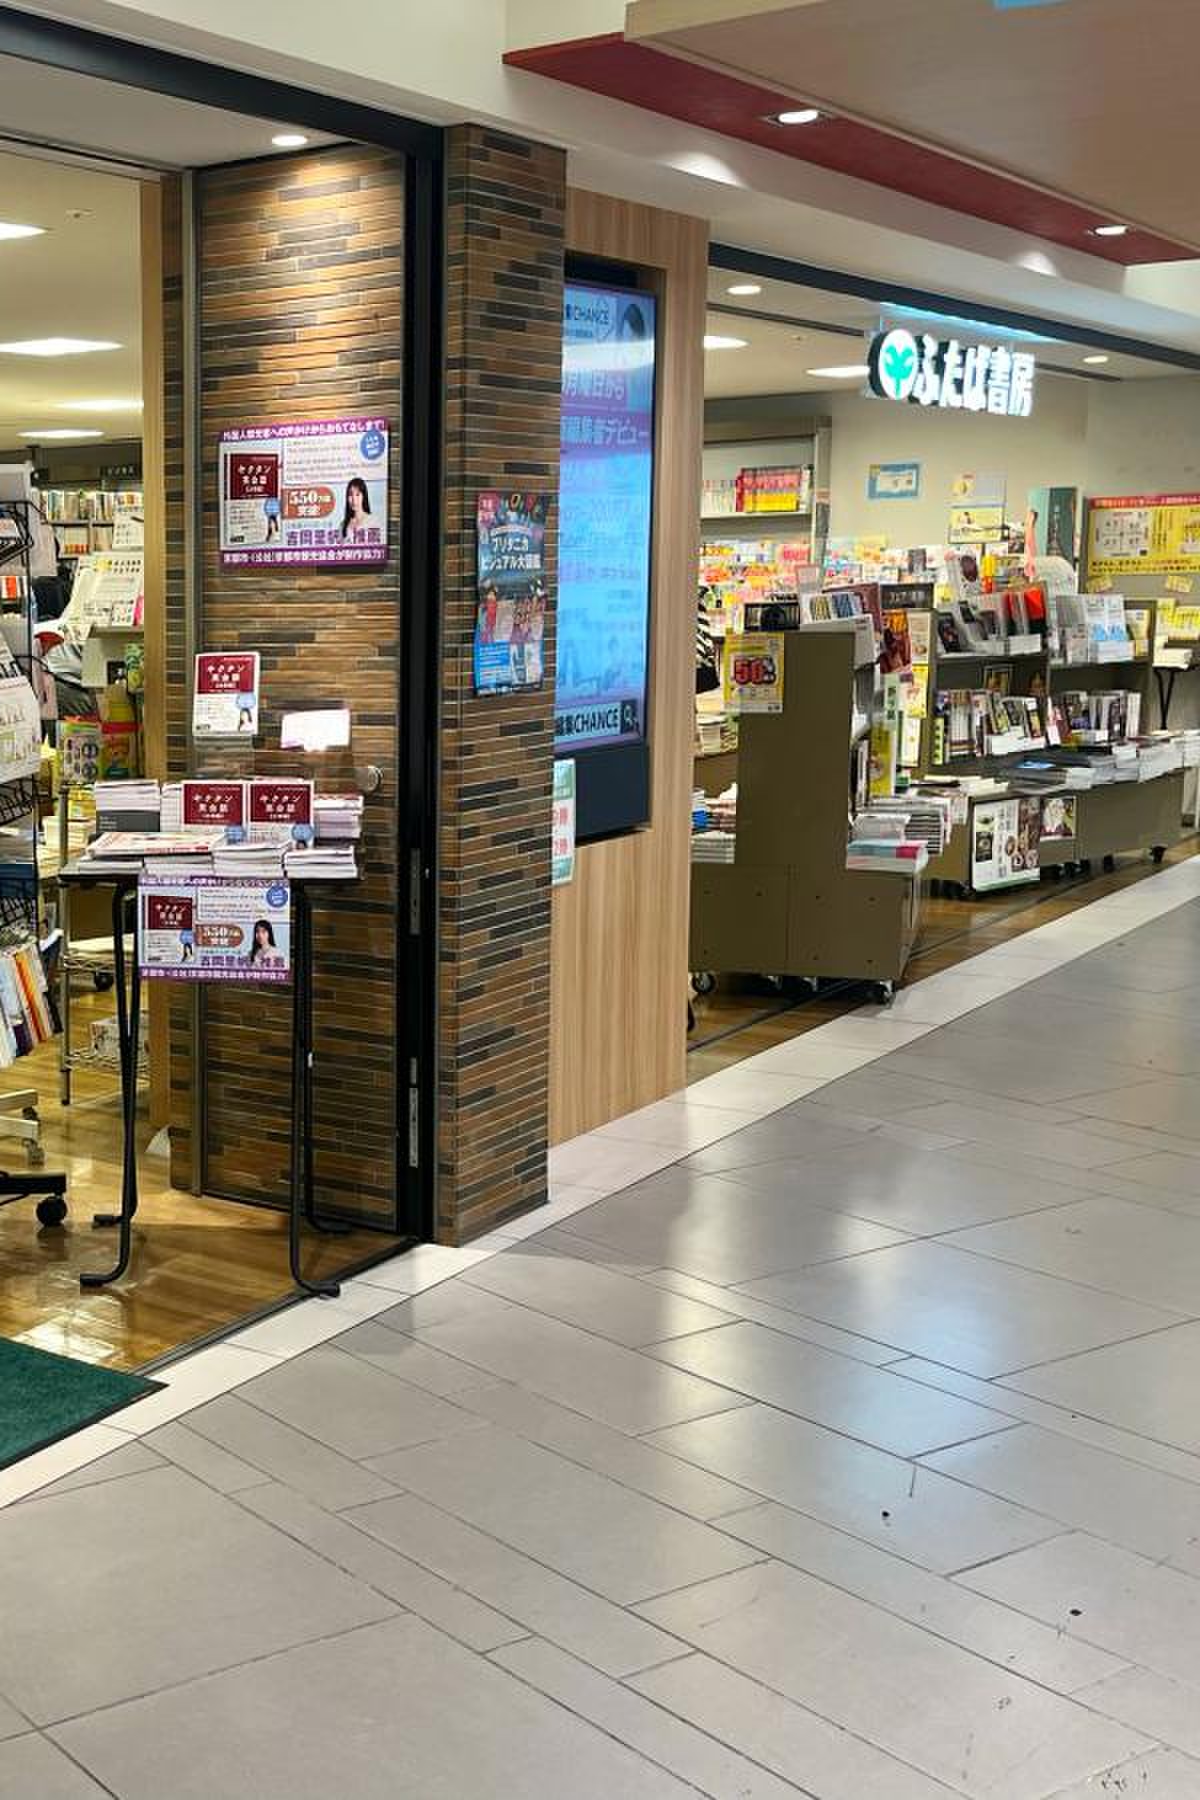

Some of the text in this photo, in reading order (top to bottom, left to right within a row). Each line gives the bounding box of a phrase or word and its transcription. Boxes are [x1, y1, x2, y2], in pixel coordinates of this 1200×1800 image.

[913, 334, 1035, 416] ふたば書房
[492, 537, 529, 553] ブリタニカ
[481, 553, 541, 571] ビジュアル大図鑑
[192, 794, 234, 803] キクタン
[259, 794, 301, 803] キクタン
[198, 803, 229, 813] 英会話
[265, 803, 296, 813] 英会話
